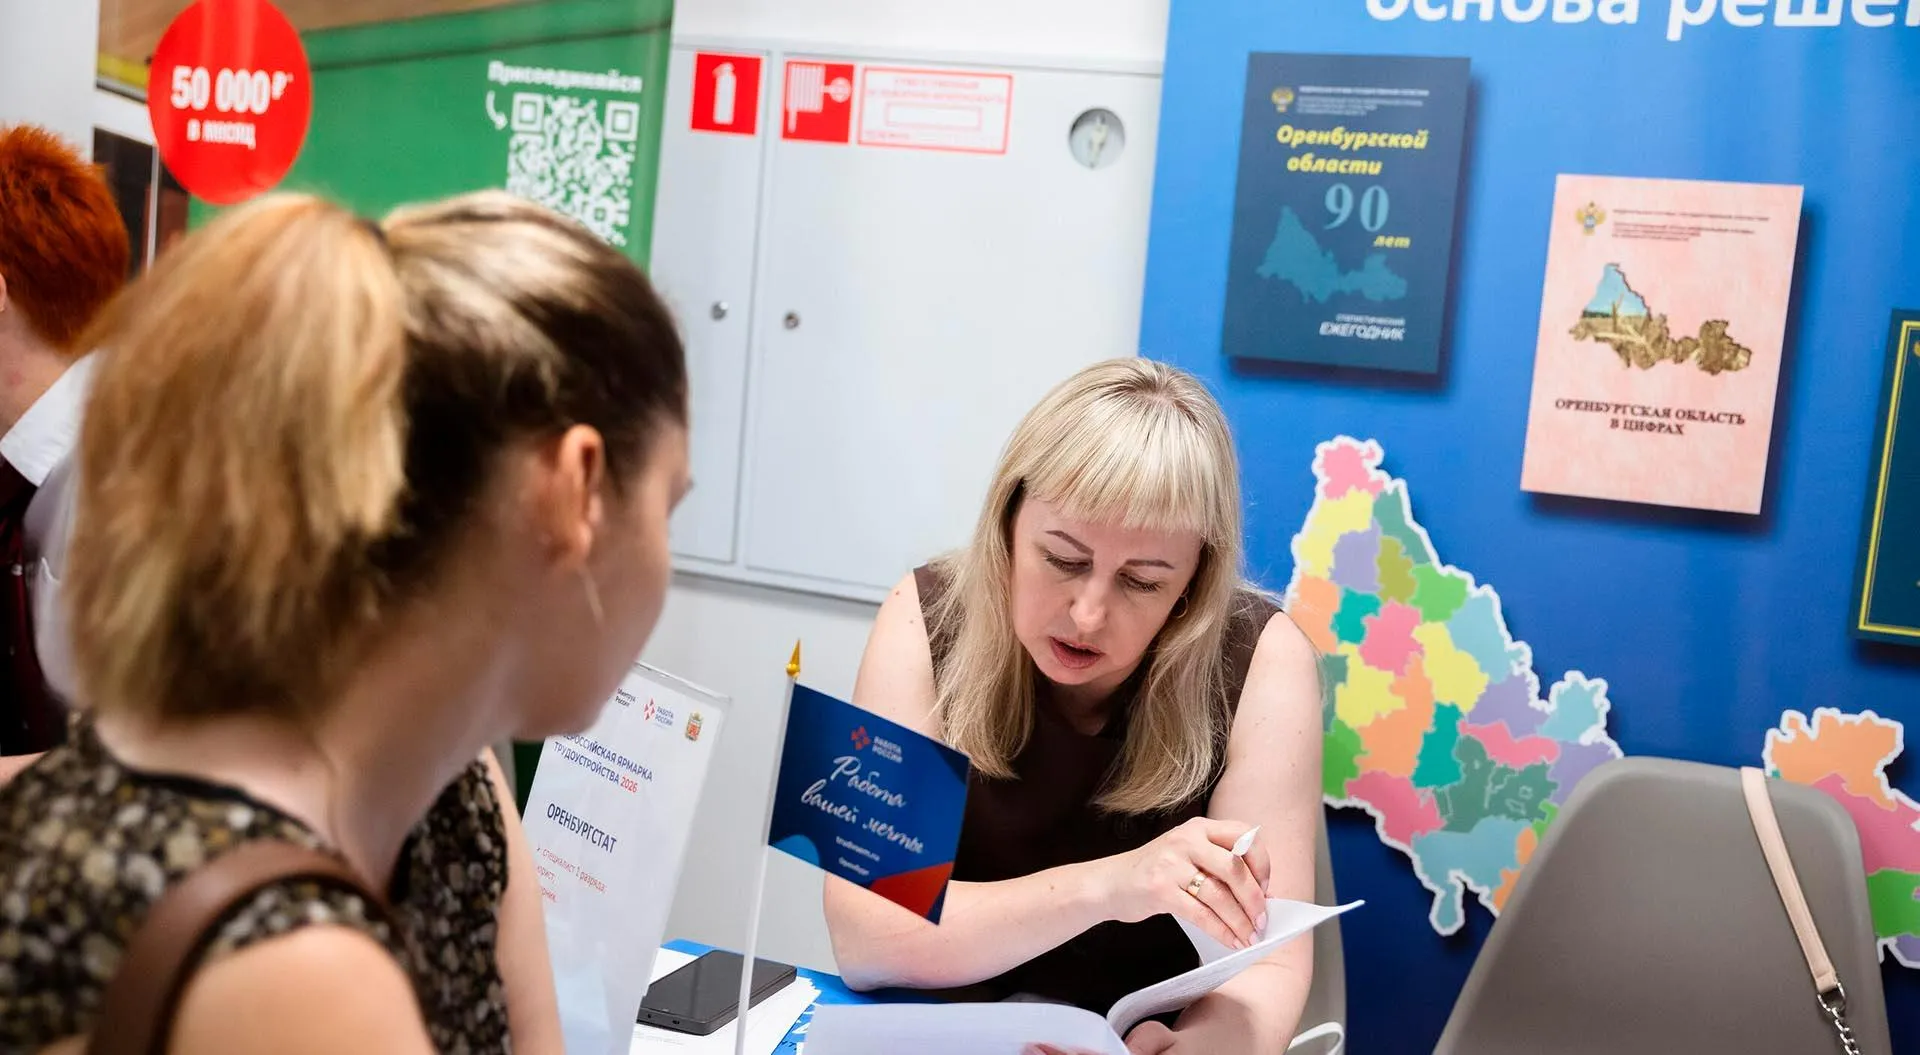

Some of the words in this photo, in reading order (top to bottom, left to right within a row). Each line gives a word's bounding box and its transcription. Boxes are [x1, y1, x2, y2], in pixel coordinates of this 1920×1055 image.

[1666, 0, 1920, 42] реше
[170, 65, 211, 111] 50
[487, 60, 643, 93] Присоединяйся
[1276, 124, 1430, 151] Оренбургской
[1286, 152, 1383, 177] области
[1324, 182, 1390, 233] 90
[1373, 233, 1411, 249] лет
[1319, 321, 1406, 341] ЕЖЕГОДНИК
[1555, 398, 1672, 419] ОРЕНБУРГСКАЯ
[1675, 408, 1746, 426] ОБЛАСТЬ
[1609, 418, 1619, 430] В
[1622, 419, 1685, 436] ЦИФРАХ
[553, 741, 620, 785] ТРУДОУСТРОЙСТВА
[620, 776, 639, 793] 2026
[617, 755, 653, 781] ЯРМАРКА
[830, 755, 907, 808] Работа
[546, 802, 617, 853] ОРЕНБУРГСТАТ
[801, 779, 859, 823] вашей
[862, 817, 924, 854] мечты
